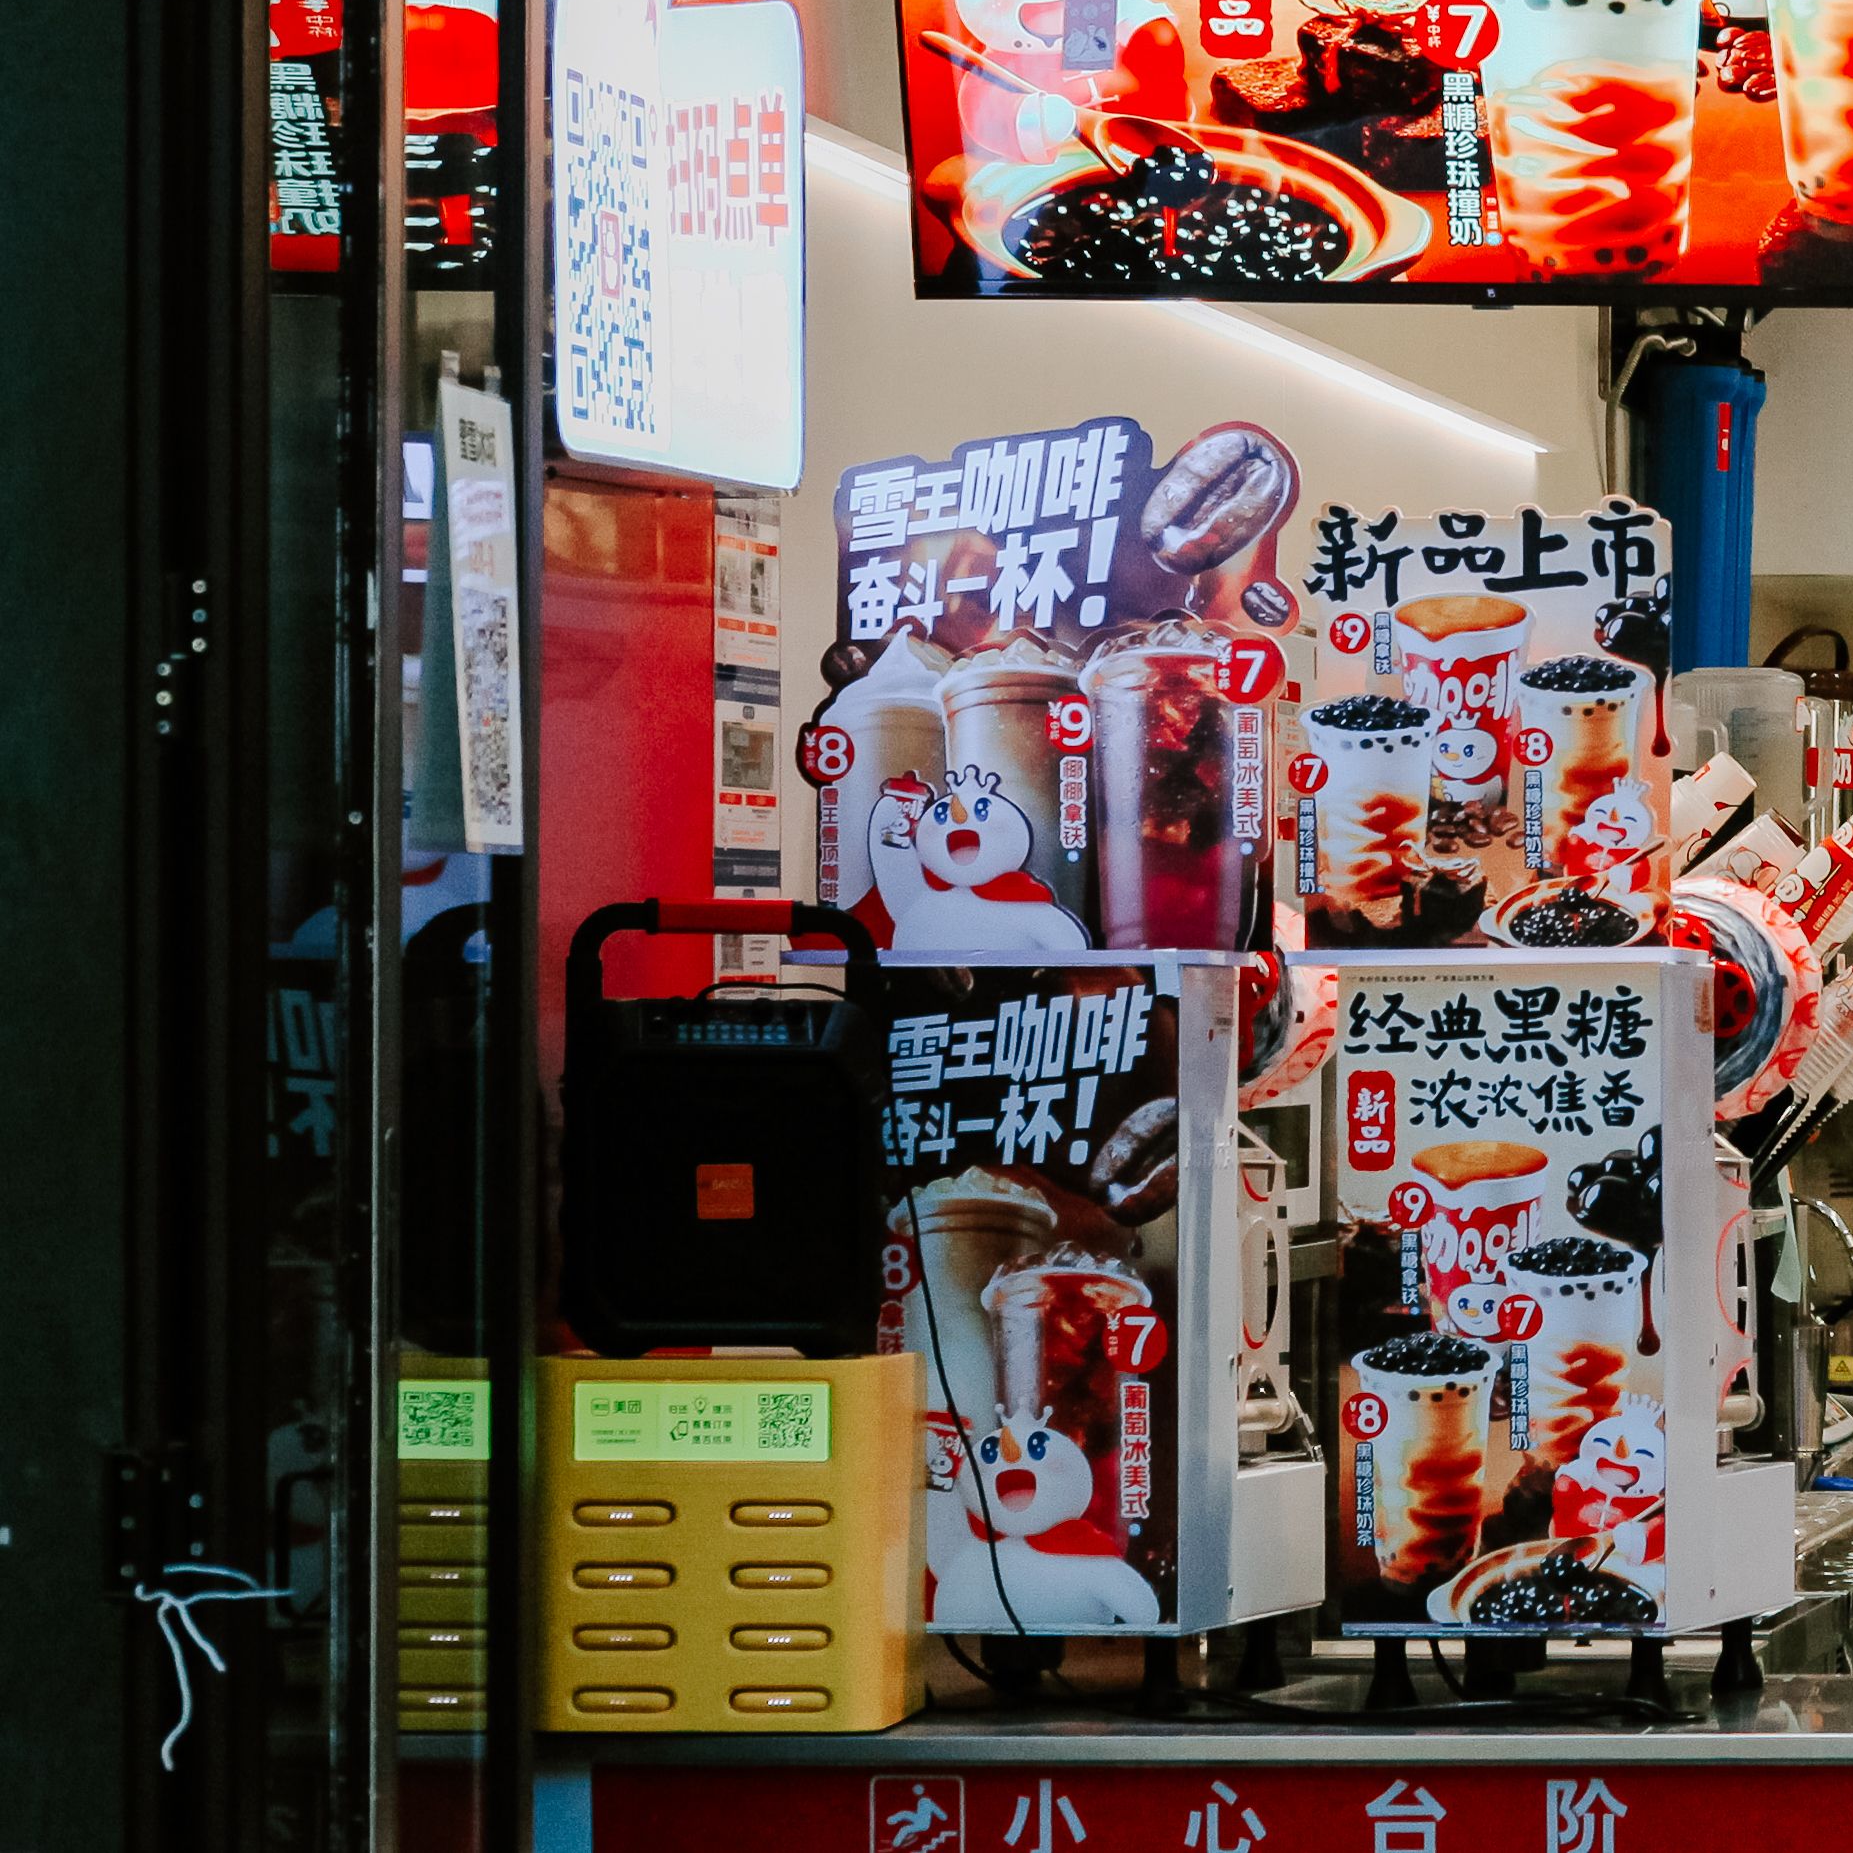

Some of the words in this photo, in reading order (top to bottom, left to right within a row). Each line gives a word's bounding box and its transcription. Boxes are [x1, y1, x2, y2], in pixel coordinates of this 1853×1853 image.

[667, 93, 790, 245] 扫码点单
[1442, 72, 1483, 247] 黑糖珍珠撞奶
[846, 426, 1129, 552] 雪王咖啡
[846, 520, 1122, 643] 奋斗一杯!
[1304, 500, 1657, 608] 新品上市
[1062, 758, 1087, 848] 椰椰拿铁
[1235, 709, 1263, 838] 葡萄冰美式
[1525, 771, 1544, 868] 黑糖珍珠奶茶
[820, 787, 841, 903] 雪王雪顶咖啡
[1297, 798, 1317, 894] 黑糖珍珠撞奶
[888, 986, 1153, 1093] 雪王咖啡
[1344, 986, 1653, 1066] 经典黑糖
[1353, 1088, 1391, 1154] 新品
[1409, 1069, 1644, 1136] 浓浓焦香
[1401, 1232, 1421, 1305] 黑糖拿铁
[613, 1400, 642, 1414] 美团
[1510, 1344, 1529, 1450] 黑糖珍珠撞奶
[1122, 1383, 1150, 1518] 葡萄冰美式
[1356, 1442, 1375, 1546] 黑糖珍珠奶茶
[1002, 1776, 1631, 1853] 小心台阶
